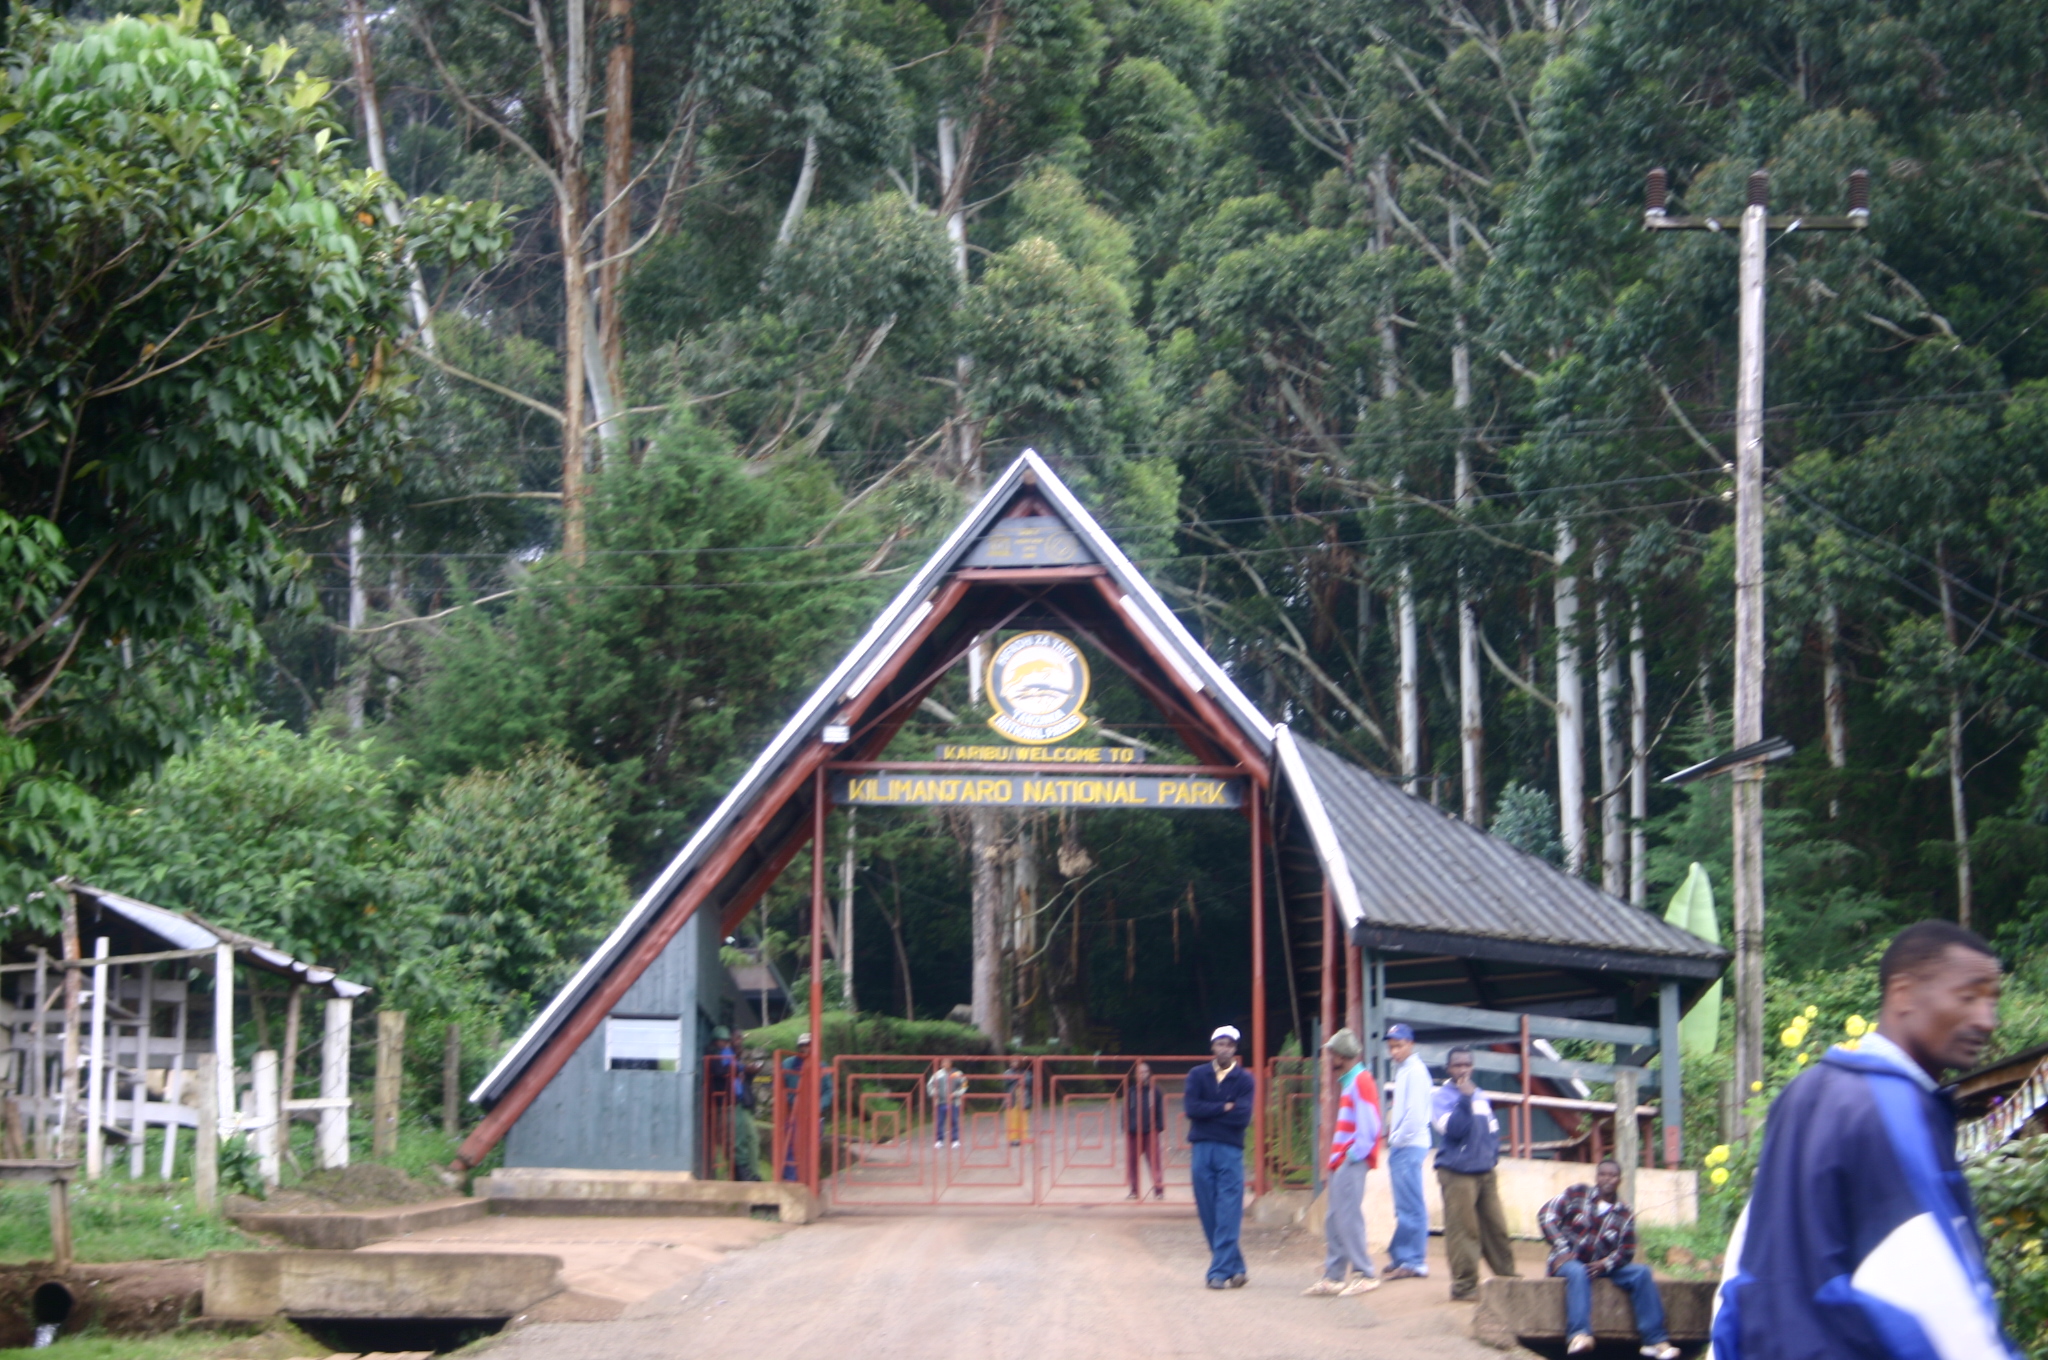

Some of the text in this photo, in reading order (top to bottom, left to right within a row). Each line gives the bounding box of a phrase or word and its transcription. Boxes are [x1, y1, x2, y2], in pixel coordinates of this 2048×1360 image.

[1109, 747, 1134, 762] TO
[849, 778, 1227, 805] KILIMANJARO NATIONAL PARK
